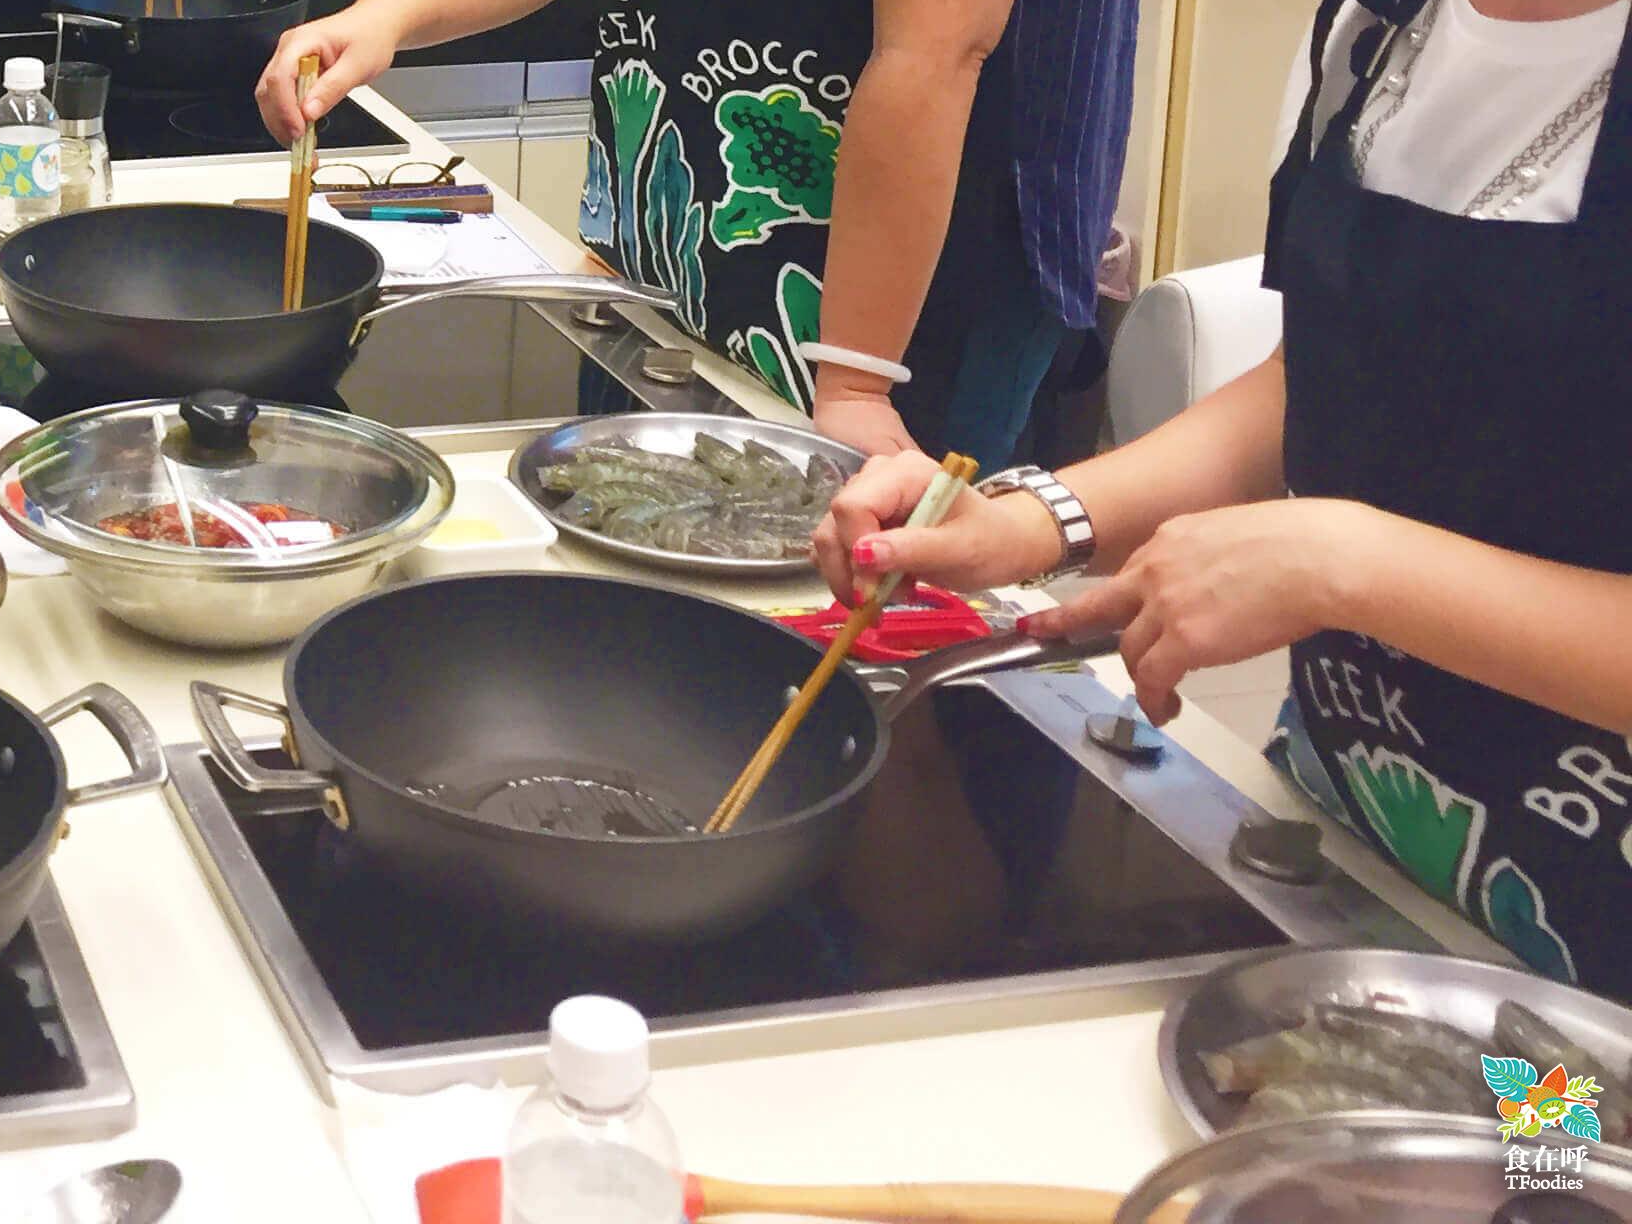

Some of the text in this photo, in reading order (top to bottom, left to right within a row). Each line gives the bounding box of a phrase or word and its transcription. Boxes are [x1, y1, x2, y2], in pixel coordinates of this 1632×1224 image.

[598, 9, 656, 54] EEK
[681, 39, 852, 105] BROCCO
[1304, 657, 1425, 747] LEEK
